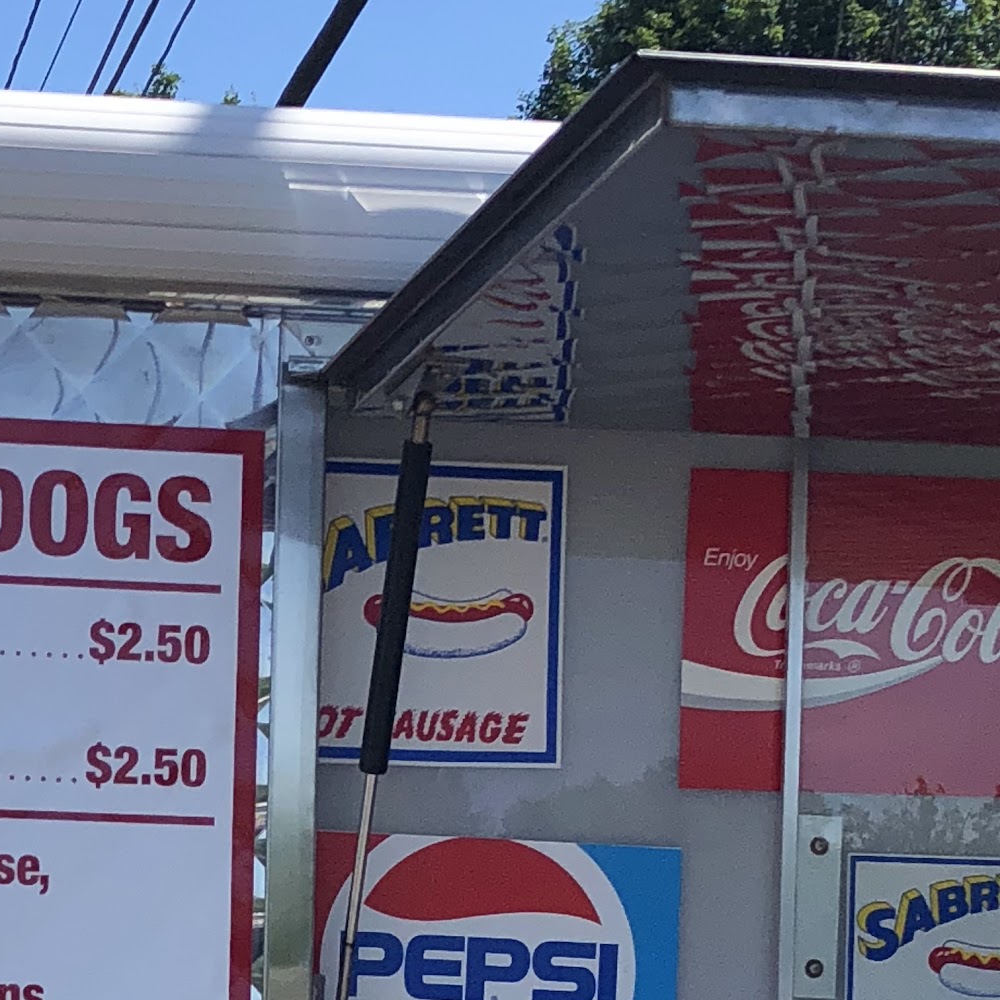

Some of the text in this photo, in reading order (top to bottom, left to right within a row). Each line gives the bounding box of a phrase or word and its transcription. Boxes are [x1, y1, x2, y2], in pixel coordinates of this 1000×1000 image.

[322, 496, 547, 593] ARETT
[704, 547, 759, 571] Enjoy
[89, 619, 211, 665] $2.50
[392, 707, 530, 744] AUSAGE
[85, 743, 207, 789] $2.50
[857, 873, 1000, 961] SABR
